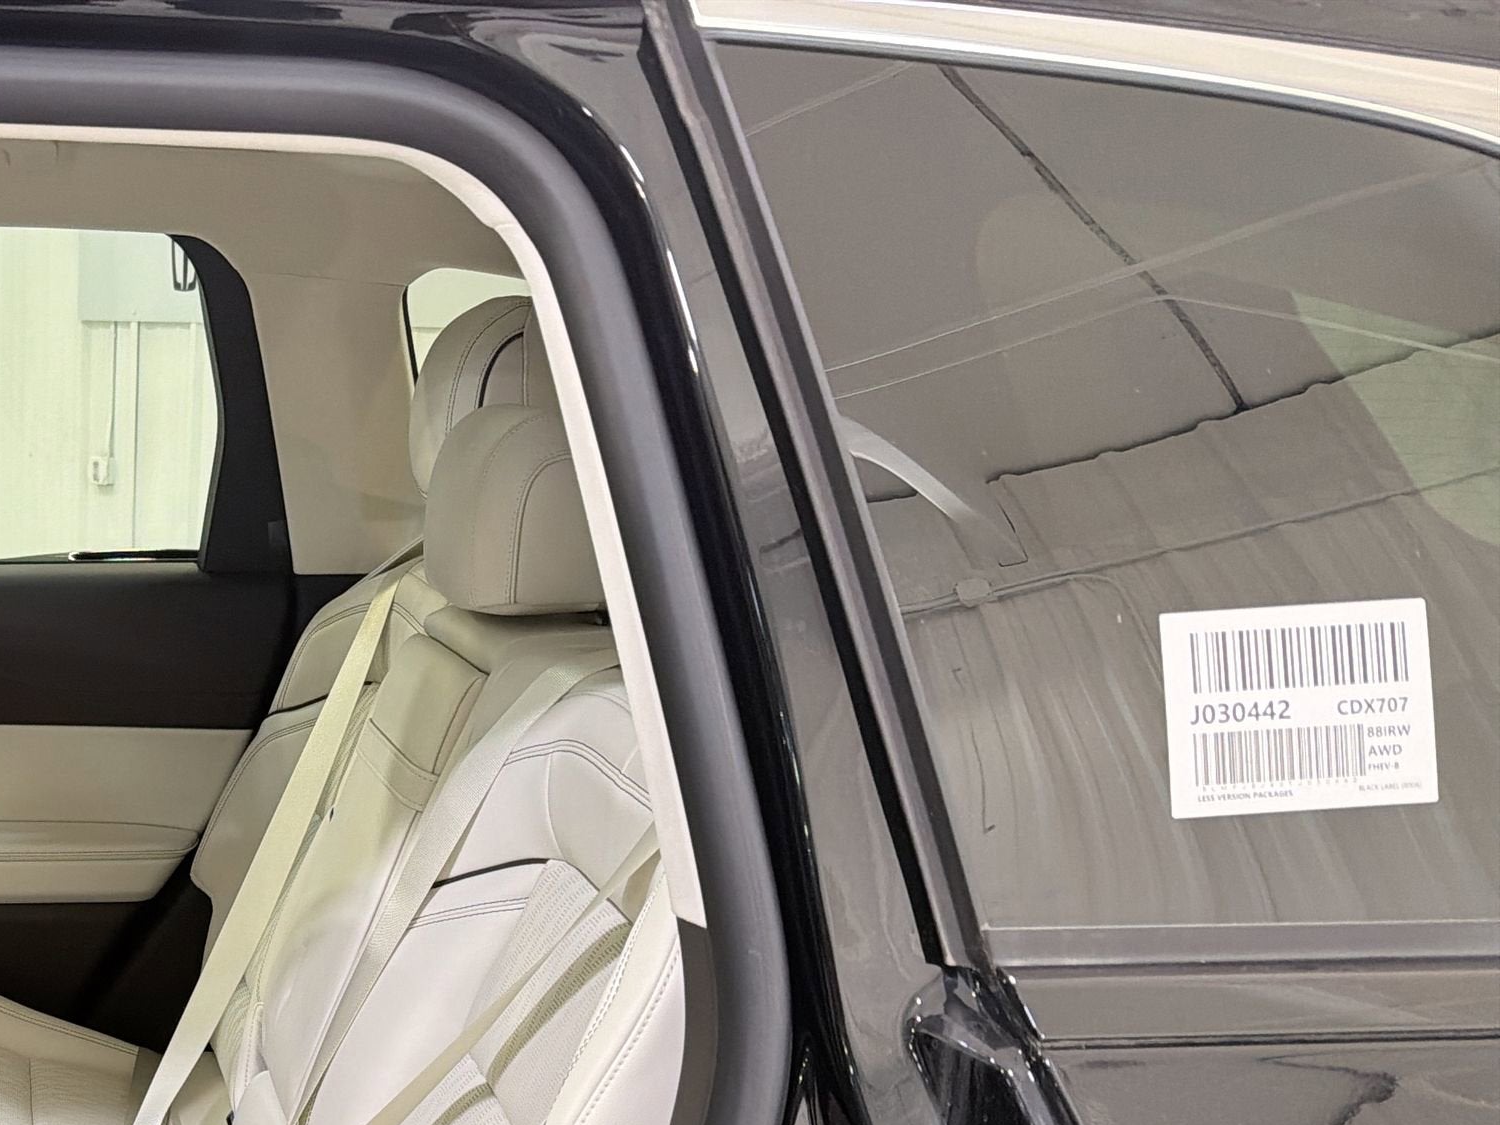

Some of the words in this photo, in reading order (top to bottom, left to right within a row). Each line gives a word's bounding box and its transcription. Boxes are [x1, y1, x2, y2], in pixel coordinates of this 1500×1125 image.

[1190, 700, 1292, 725] J030442
[1337, 697, 1409, 716] CDX707
[1368, 744, 1403, 757] AWD
